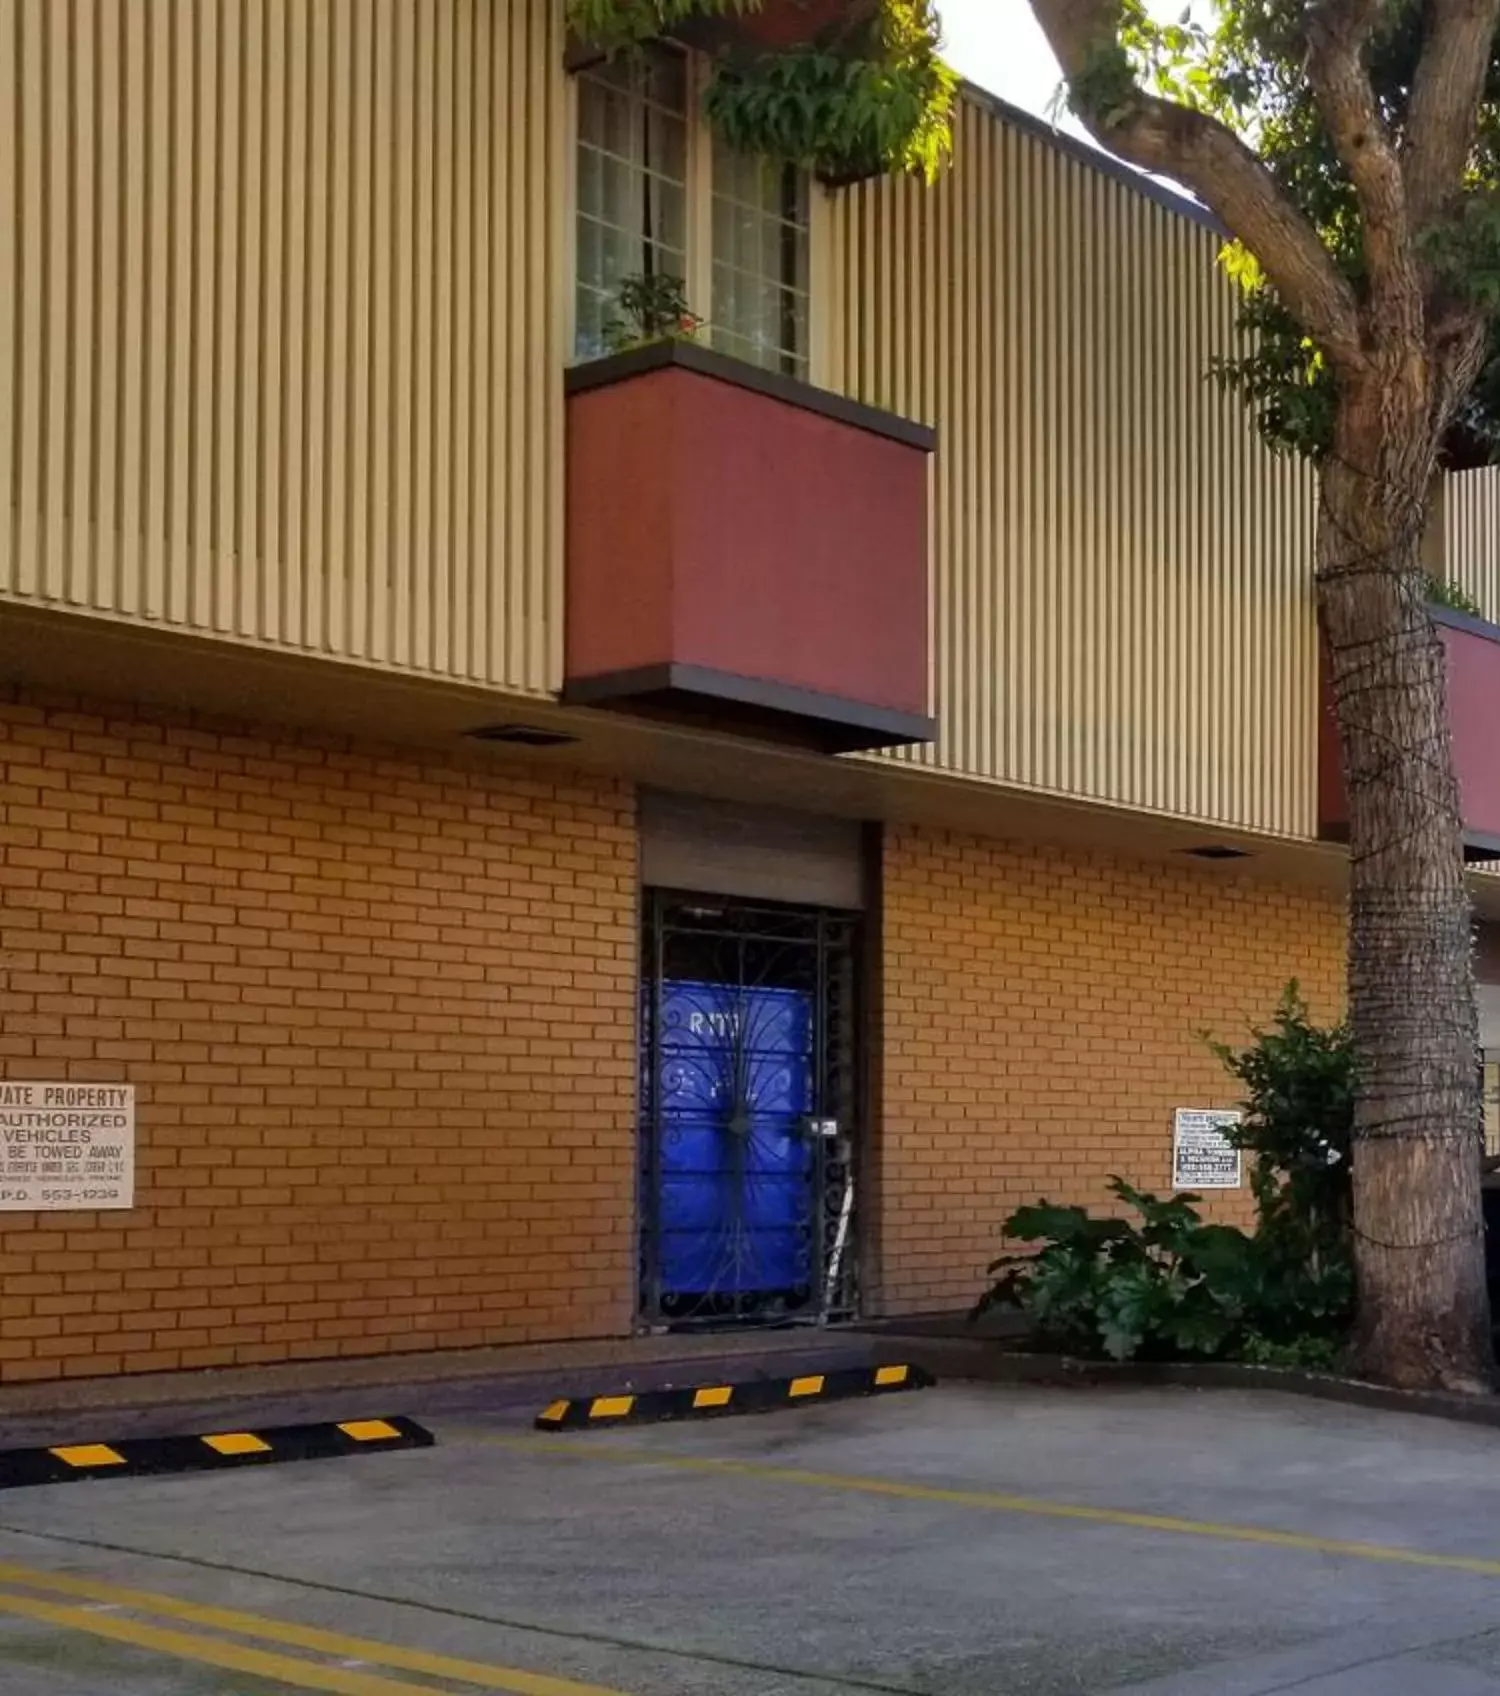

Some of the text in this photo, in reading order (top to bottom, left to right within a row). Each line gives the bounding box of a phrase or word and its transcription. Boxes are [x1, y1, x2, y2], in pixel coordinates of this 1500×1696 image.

[45, 1087, 127, 1106] PROPERTY
[0, 1113, 127, 1127] AUTHORIZED
[4, 1129, 91, 1143] VEHICLES
[8, 1145, 123, 1159] BE TOWED AWAY
